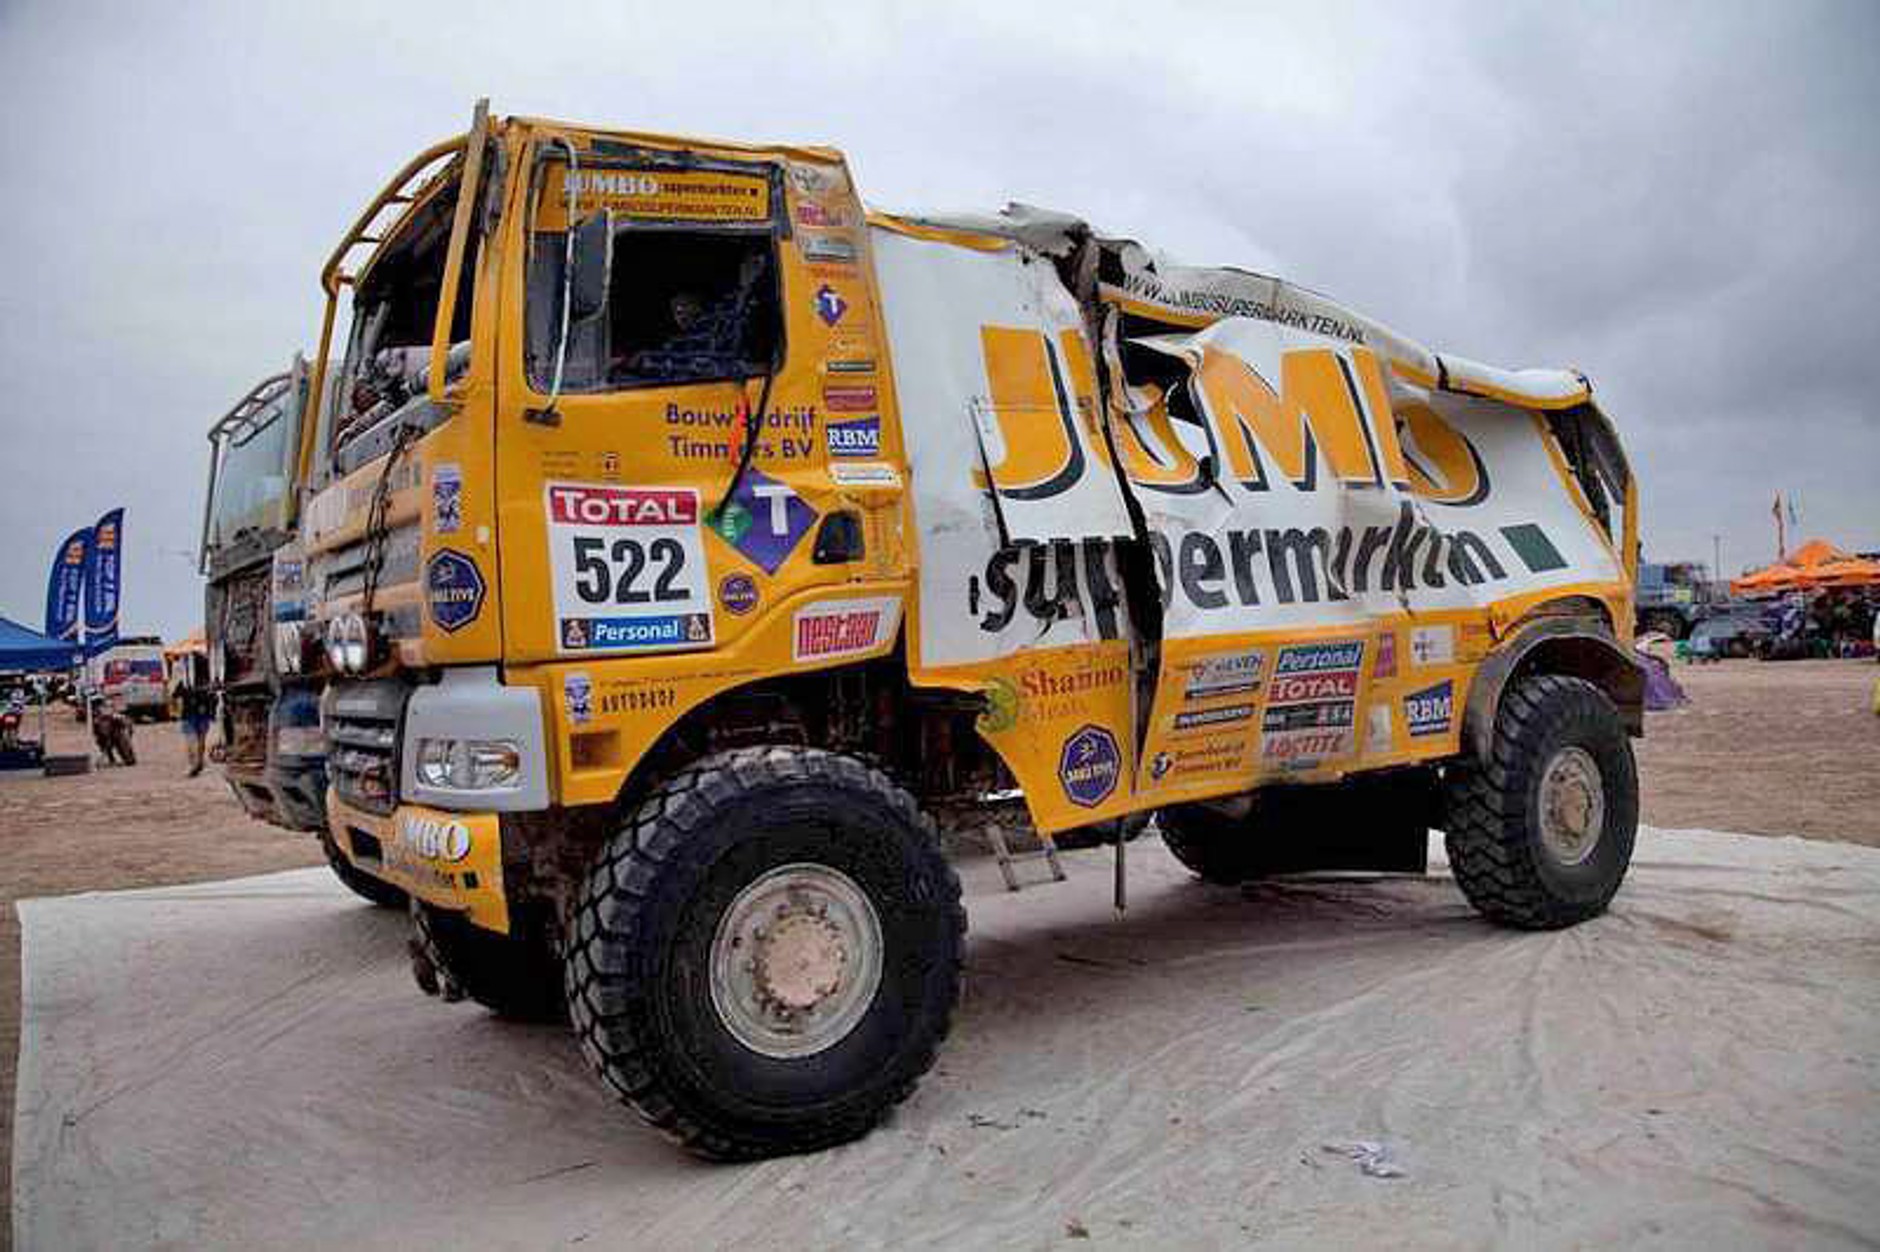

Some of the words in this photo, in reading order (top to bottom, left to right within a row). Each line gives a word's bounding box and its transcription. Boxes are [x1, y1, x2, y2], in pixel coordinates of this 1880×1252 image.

[666, 403, 816, 434] Bouwbdrijf
[669, 435, 776, 460] Timmrs
[782, 439, 814, 459] BV
[828, 429, 878, 446] RBM
[553, 489, 694, 522] TOTAL
[574, 536, 692, 604] 522
[594, 620, 678, 642] Personal
[1276, 679, 1352, 702] TOTAL
